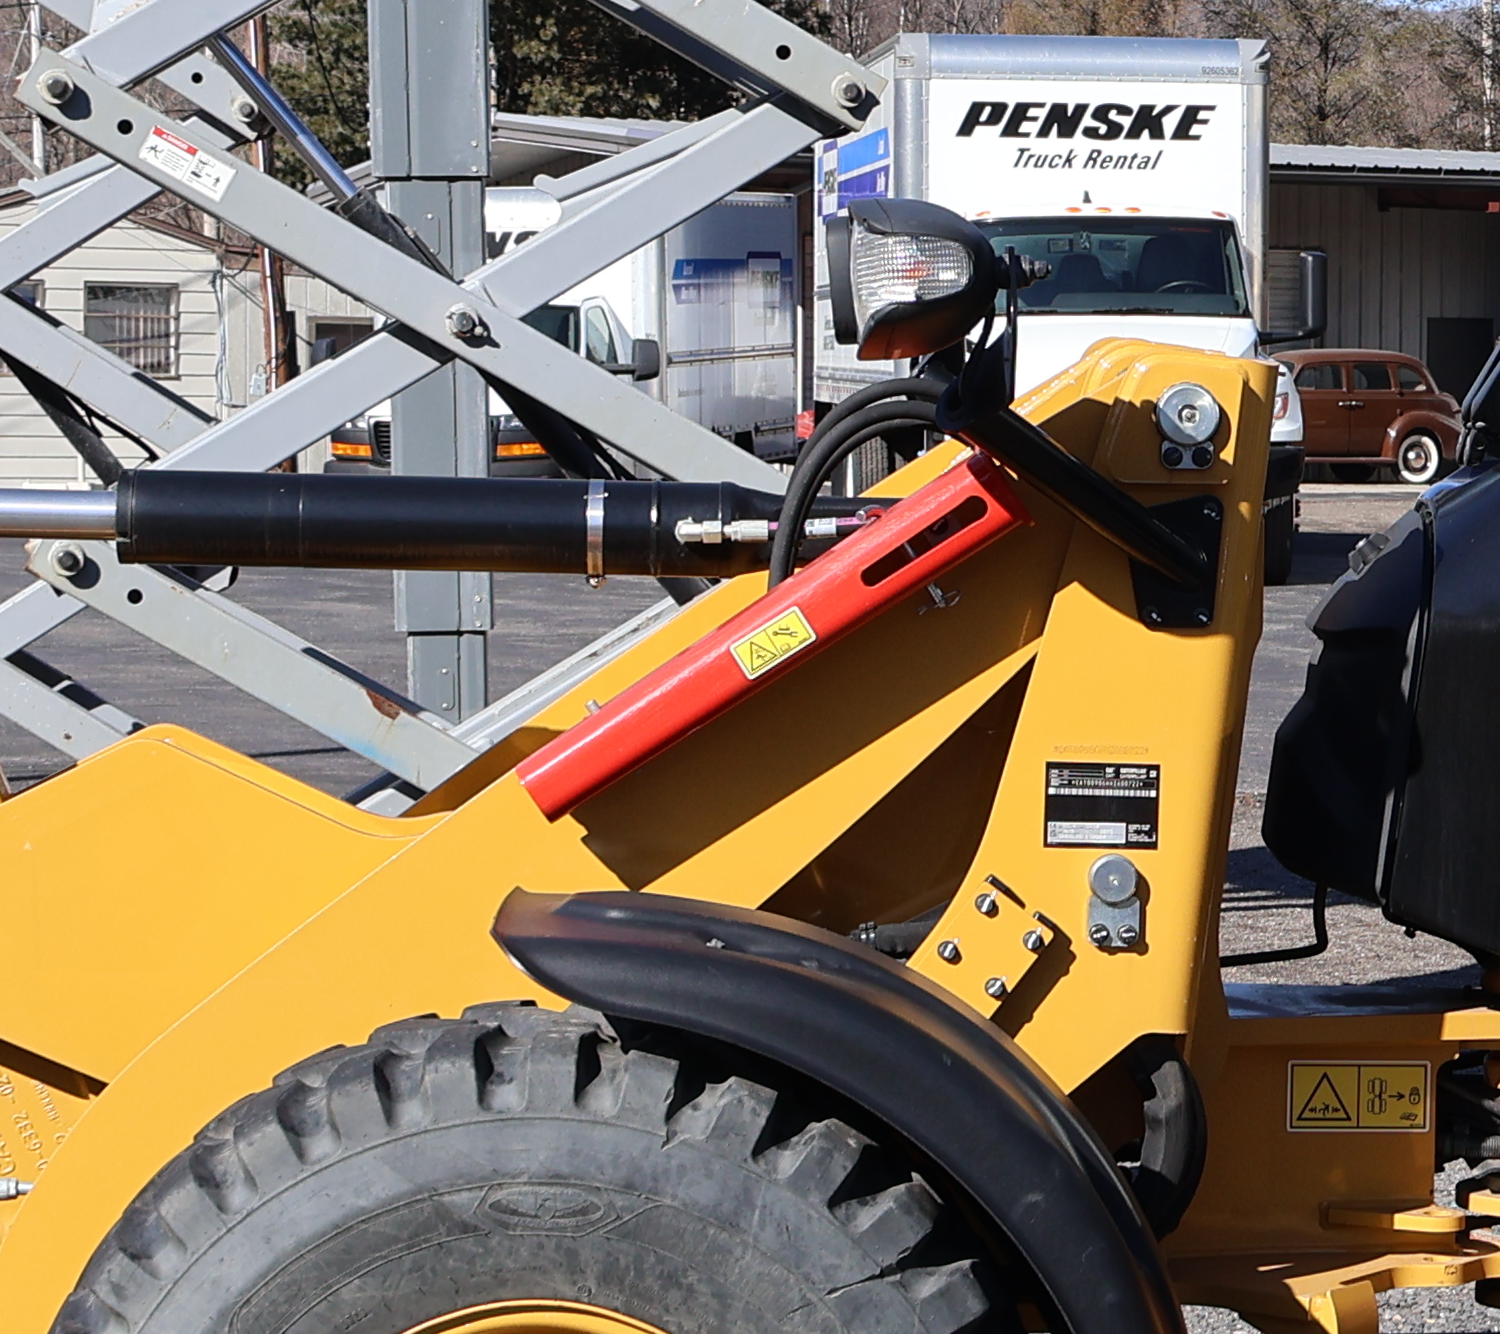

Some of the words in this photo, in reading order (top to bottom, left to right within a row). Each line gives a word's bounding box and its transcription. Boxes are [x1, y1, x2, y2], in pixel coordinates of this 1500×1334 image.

[955, 100, 1217, 141] PENSKE
[1013, 146, 1078, 169] Truck
[1083, 148, 1164, 171] Rental
